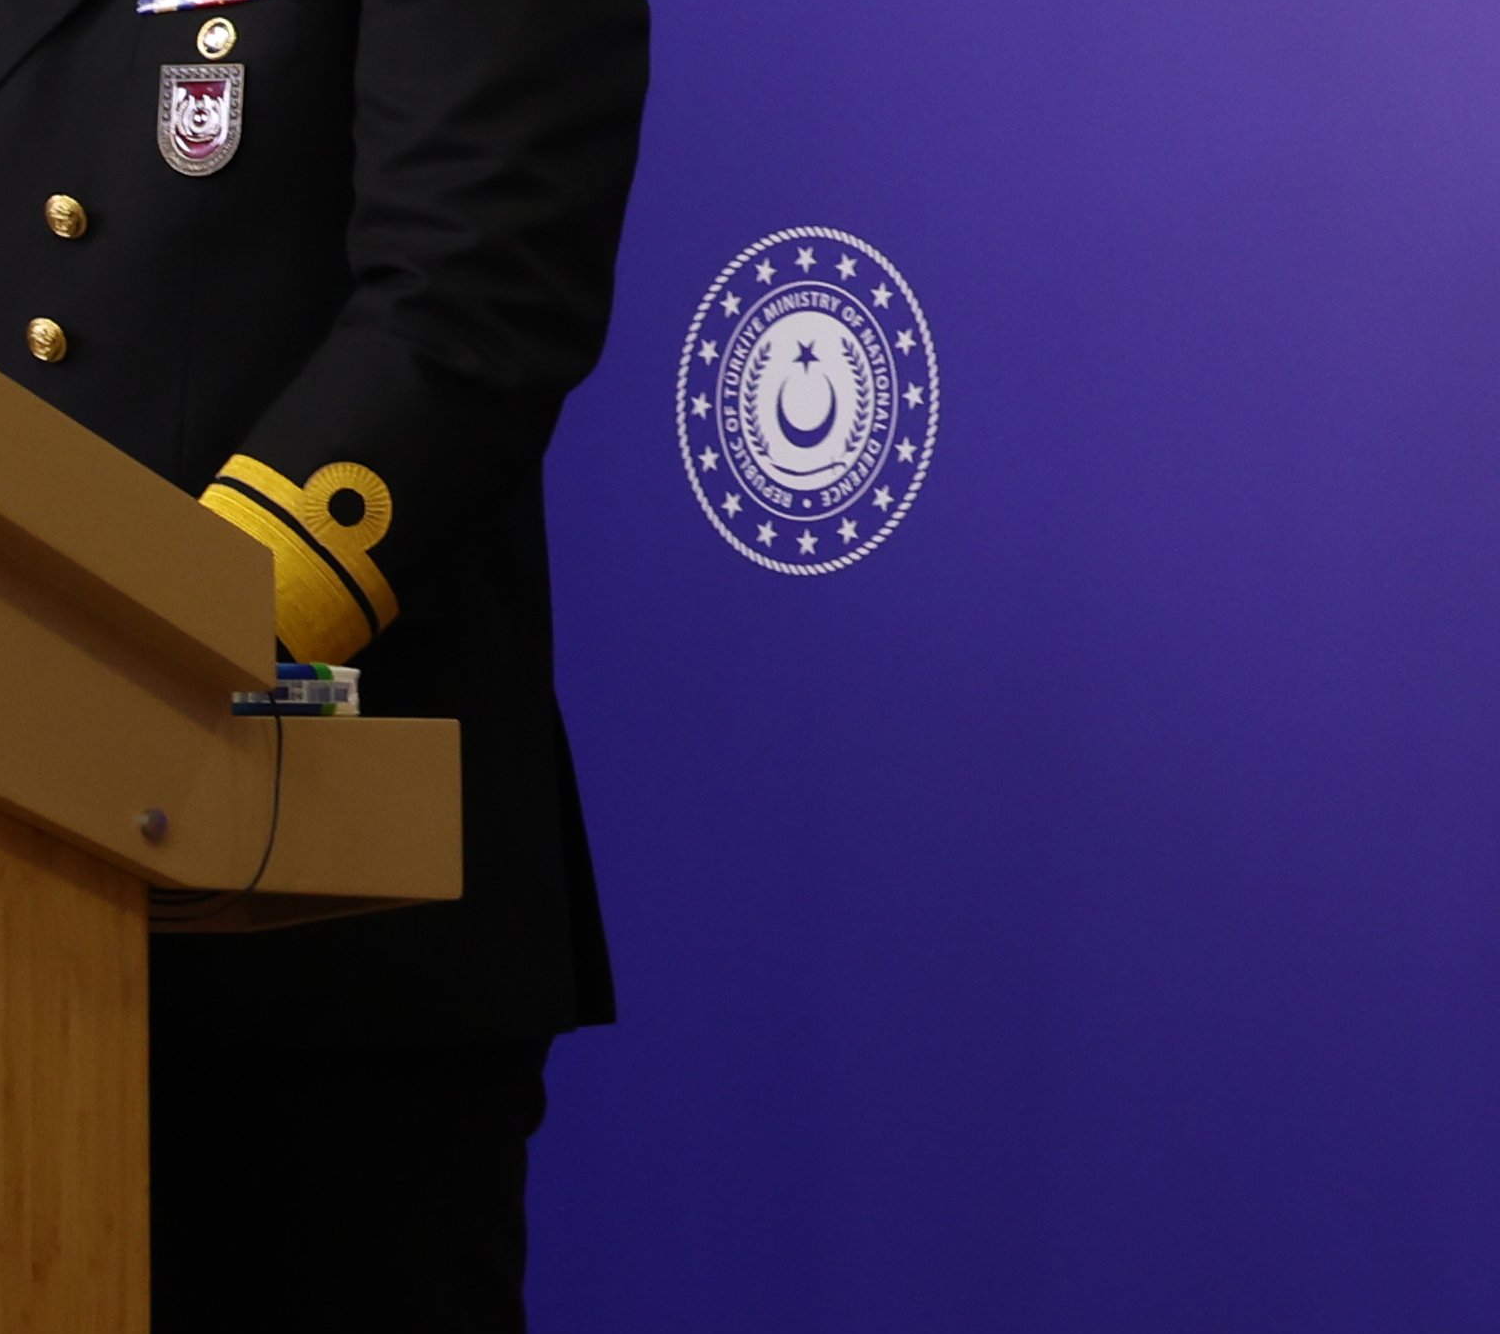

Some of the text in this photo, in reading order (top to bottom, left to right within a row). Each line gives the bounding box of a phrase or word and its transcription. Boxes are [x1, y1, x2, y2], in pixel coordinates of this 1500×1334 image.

[762, 291, 843, 323] MINISTRY
[840, 305, 865, 328] OF
[859, 327, 891, 431] NATIONAL
[723, 405, 740, 434] OF
[730, 436, 793, 509] REPUBLIC
[819, 438, 882, 508] DEFENCE
